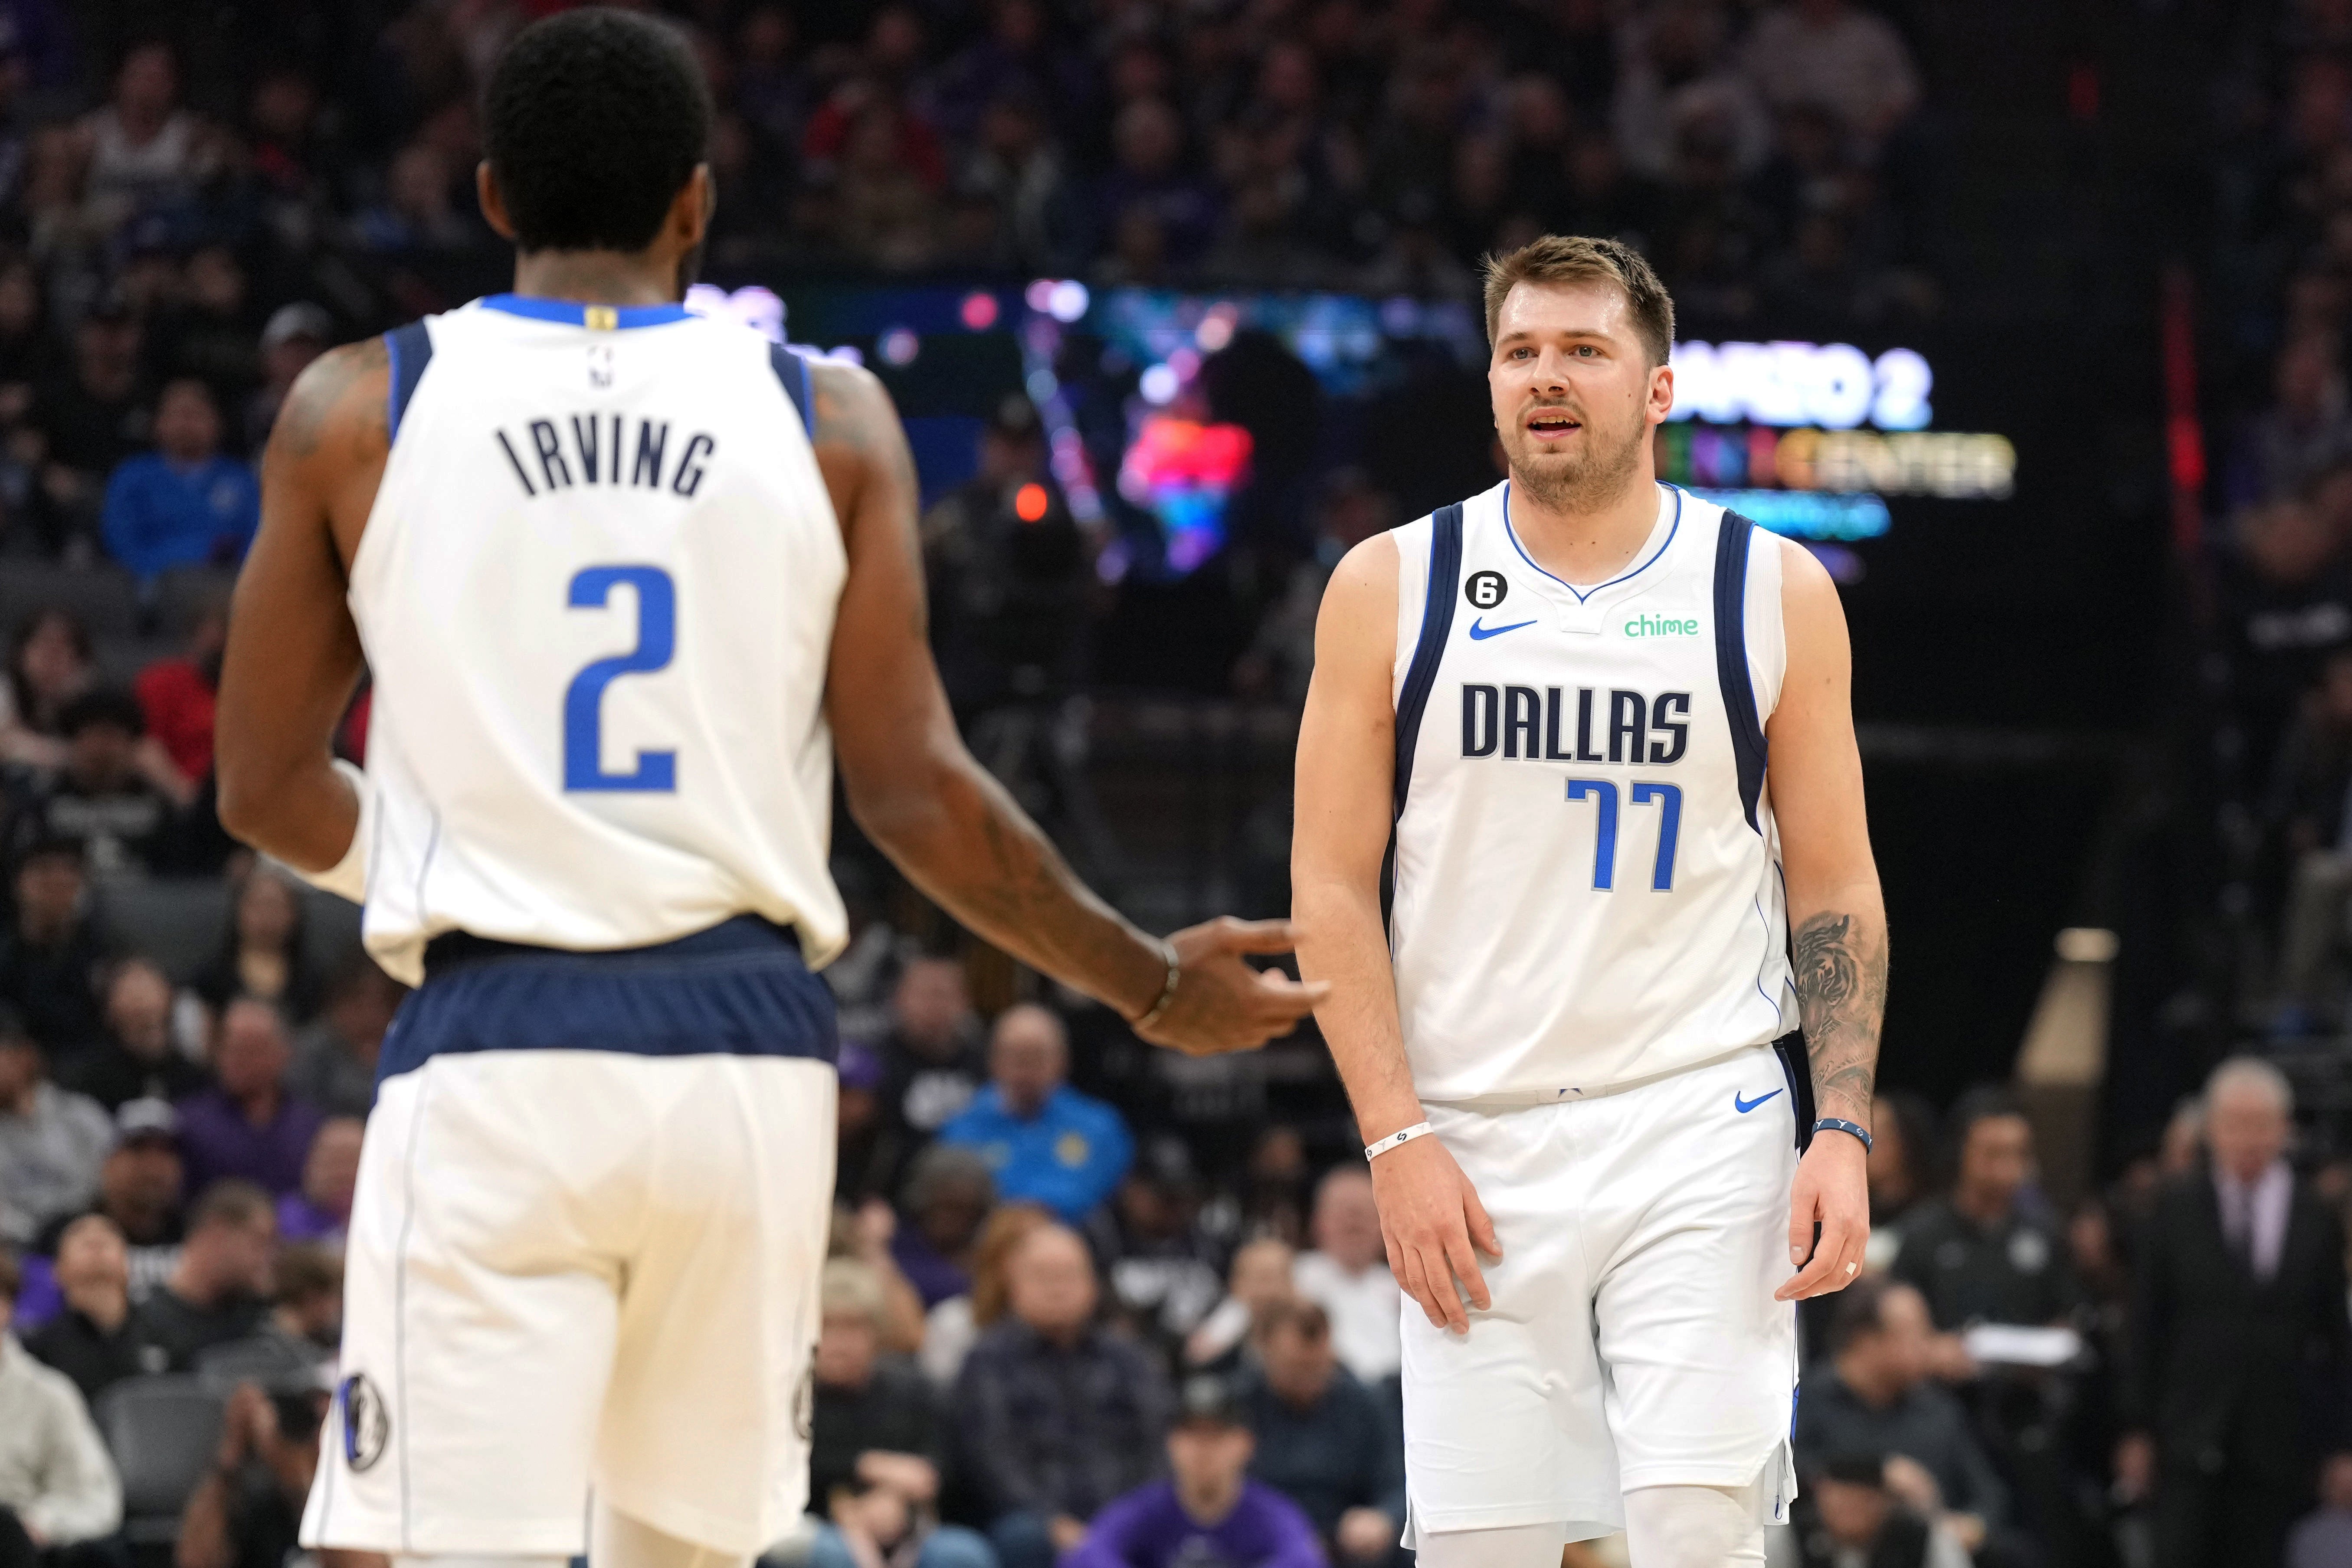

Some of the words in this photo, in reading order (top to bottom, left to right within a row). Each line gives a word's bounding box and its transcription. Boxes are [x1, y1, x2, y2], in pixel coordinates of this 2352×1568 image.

[495, 414, 716, 499] IRVING
[1475, 576, 1498, 604] 6
[1624, 614, 1699, 637] chime
[562, 563, 677, 795] 2
[1460, 682, 1692, 766] DALLAS
[1564, 776, 1684, 893] 77
